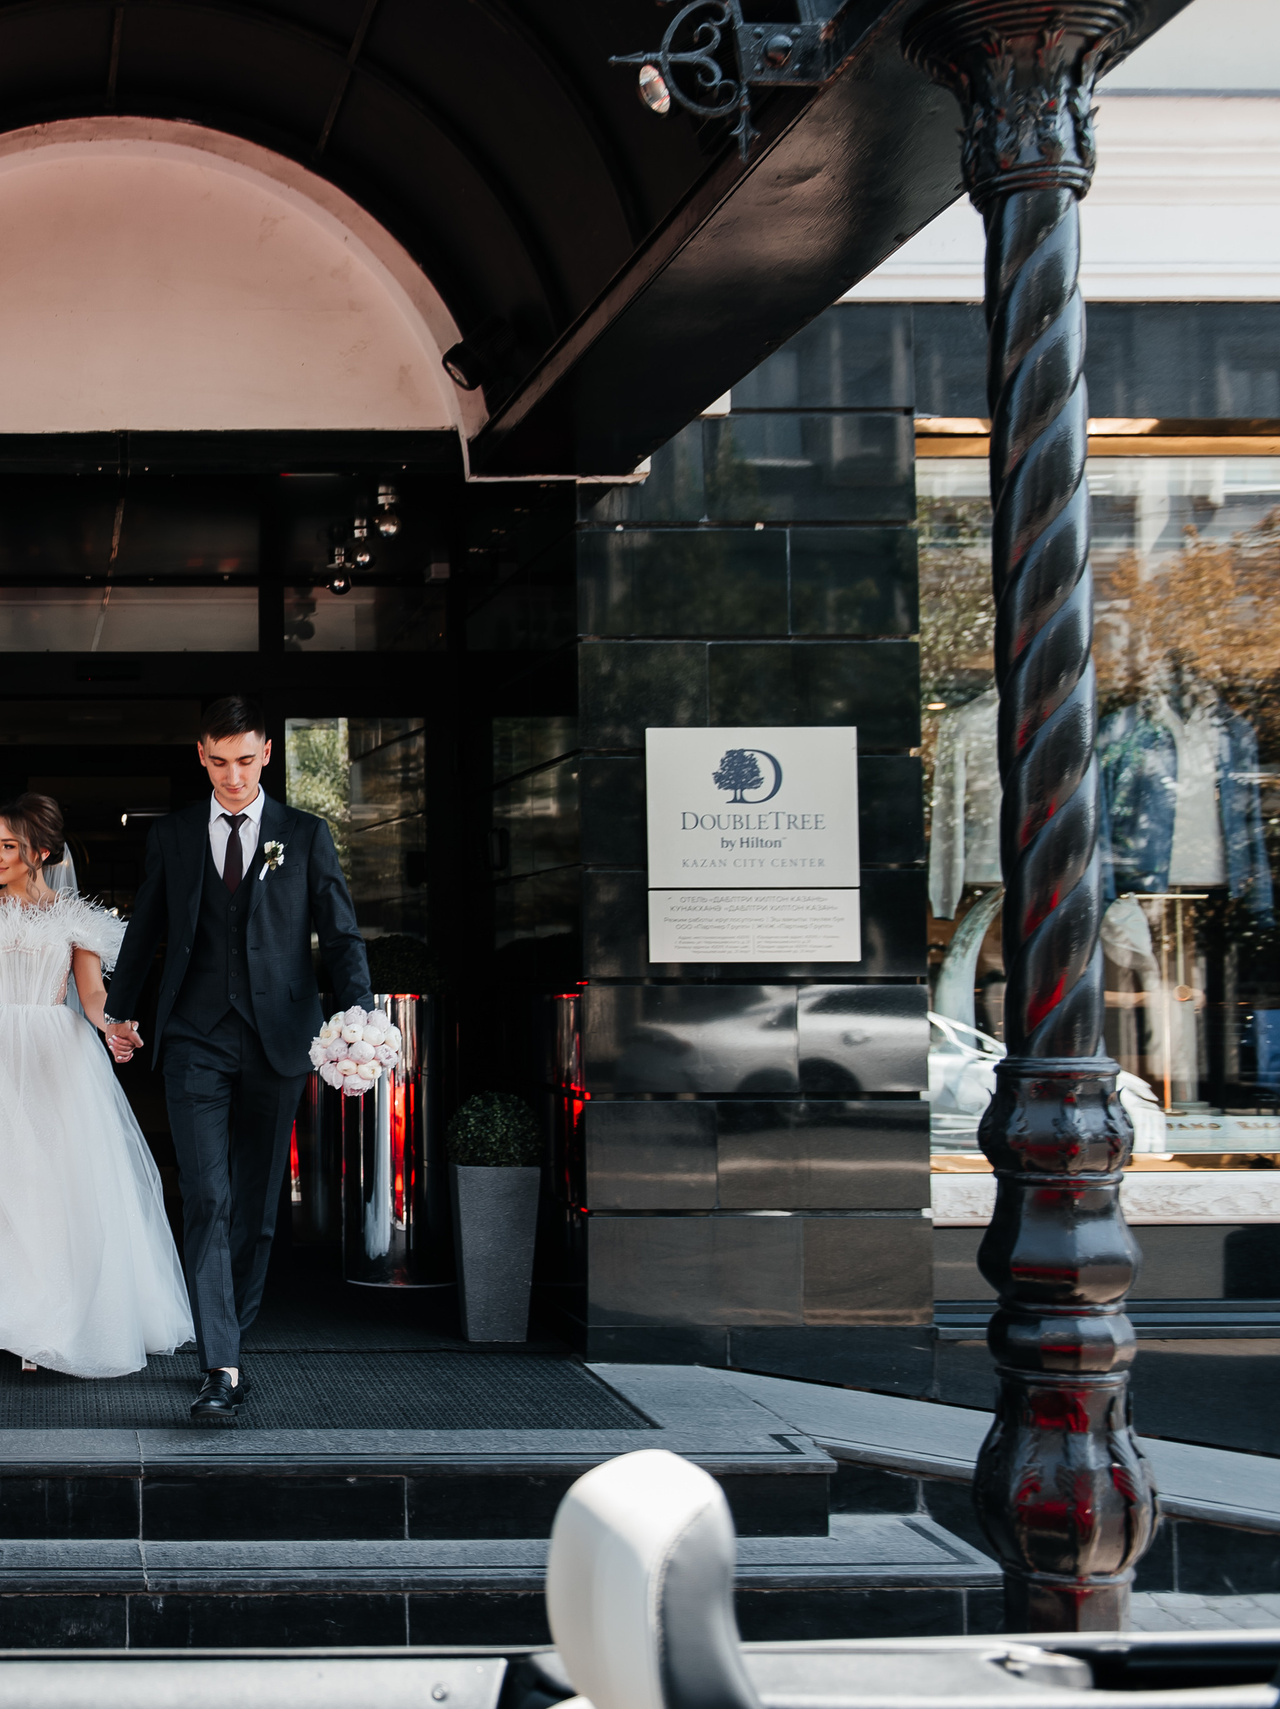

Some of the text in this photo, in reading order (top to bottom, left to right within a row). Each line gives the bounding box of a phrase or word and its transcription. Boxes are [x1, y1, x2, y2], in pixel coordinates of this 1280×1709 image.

[720, 837, 782, 852] by Hilton
[682, 858, 826, 868] KAZAN CITY CENTER
